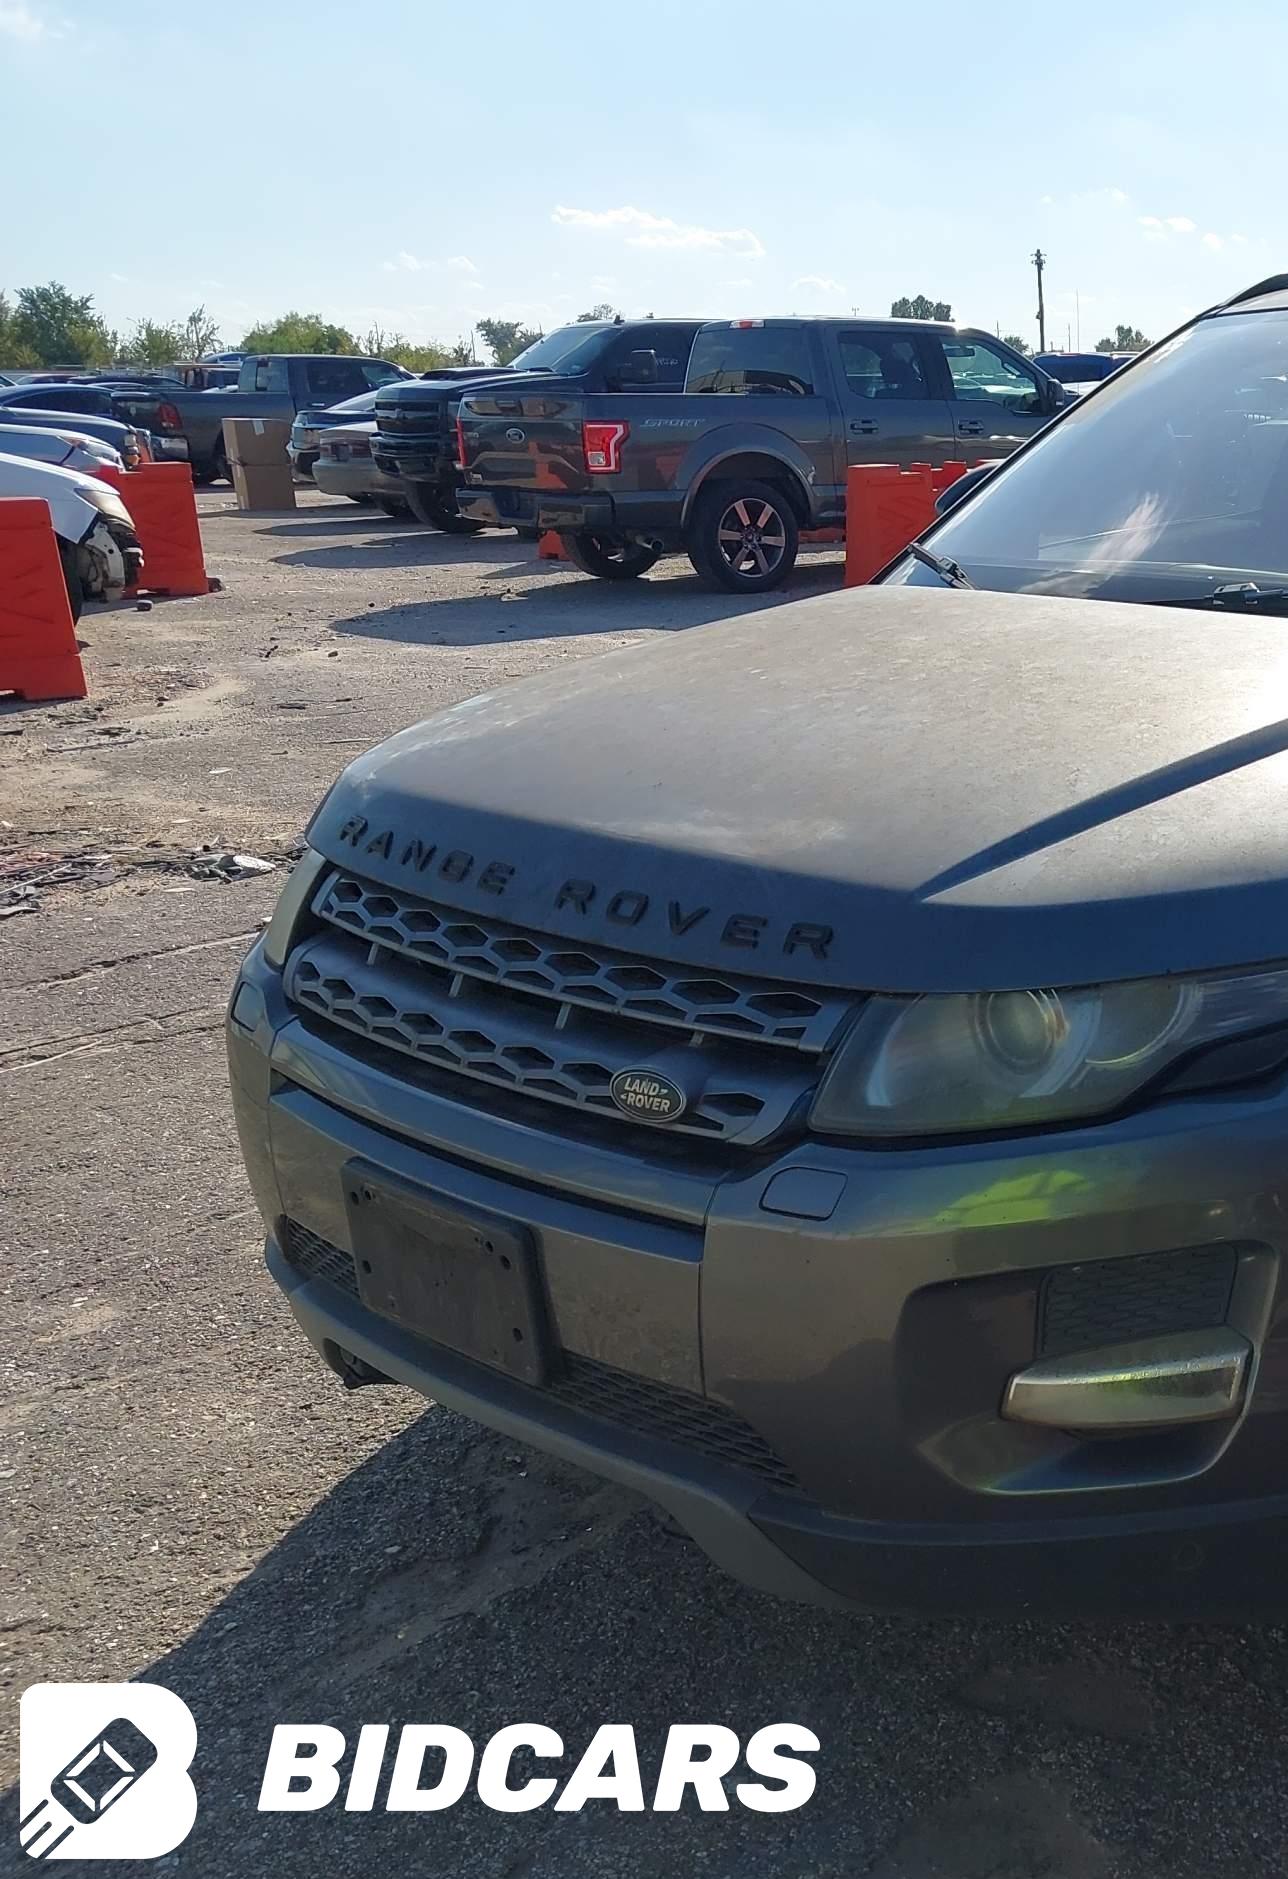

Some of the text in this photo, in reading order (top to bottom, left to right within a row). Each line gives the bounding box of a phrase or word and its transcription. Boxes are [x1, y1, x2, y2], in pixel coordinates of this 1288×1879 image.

[640, 418, 705, 428] SPORT
[338, 814, 835, 959] RANGE ROVER
[624, 1077, 660, 1096] LAND
[627, 1092, 671, 1113] ROVER
